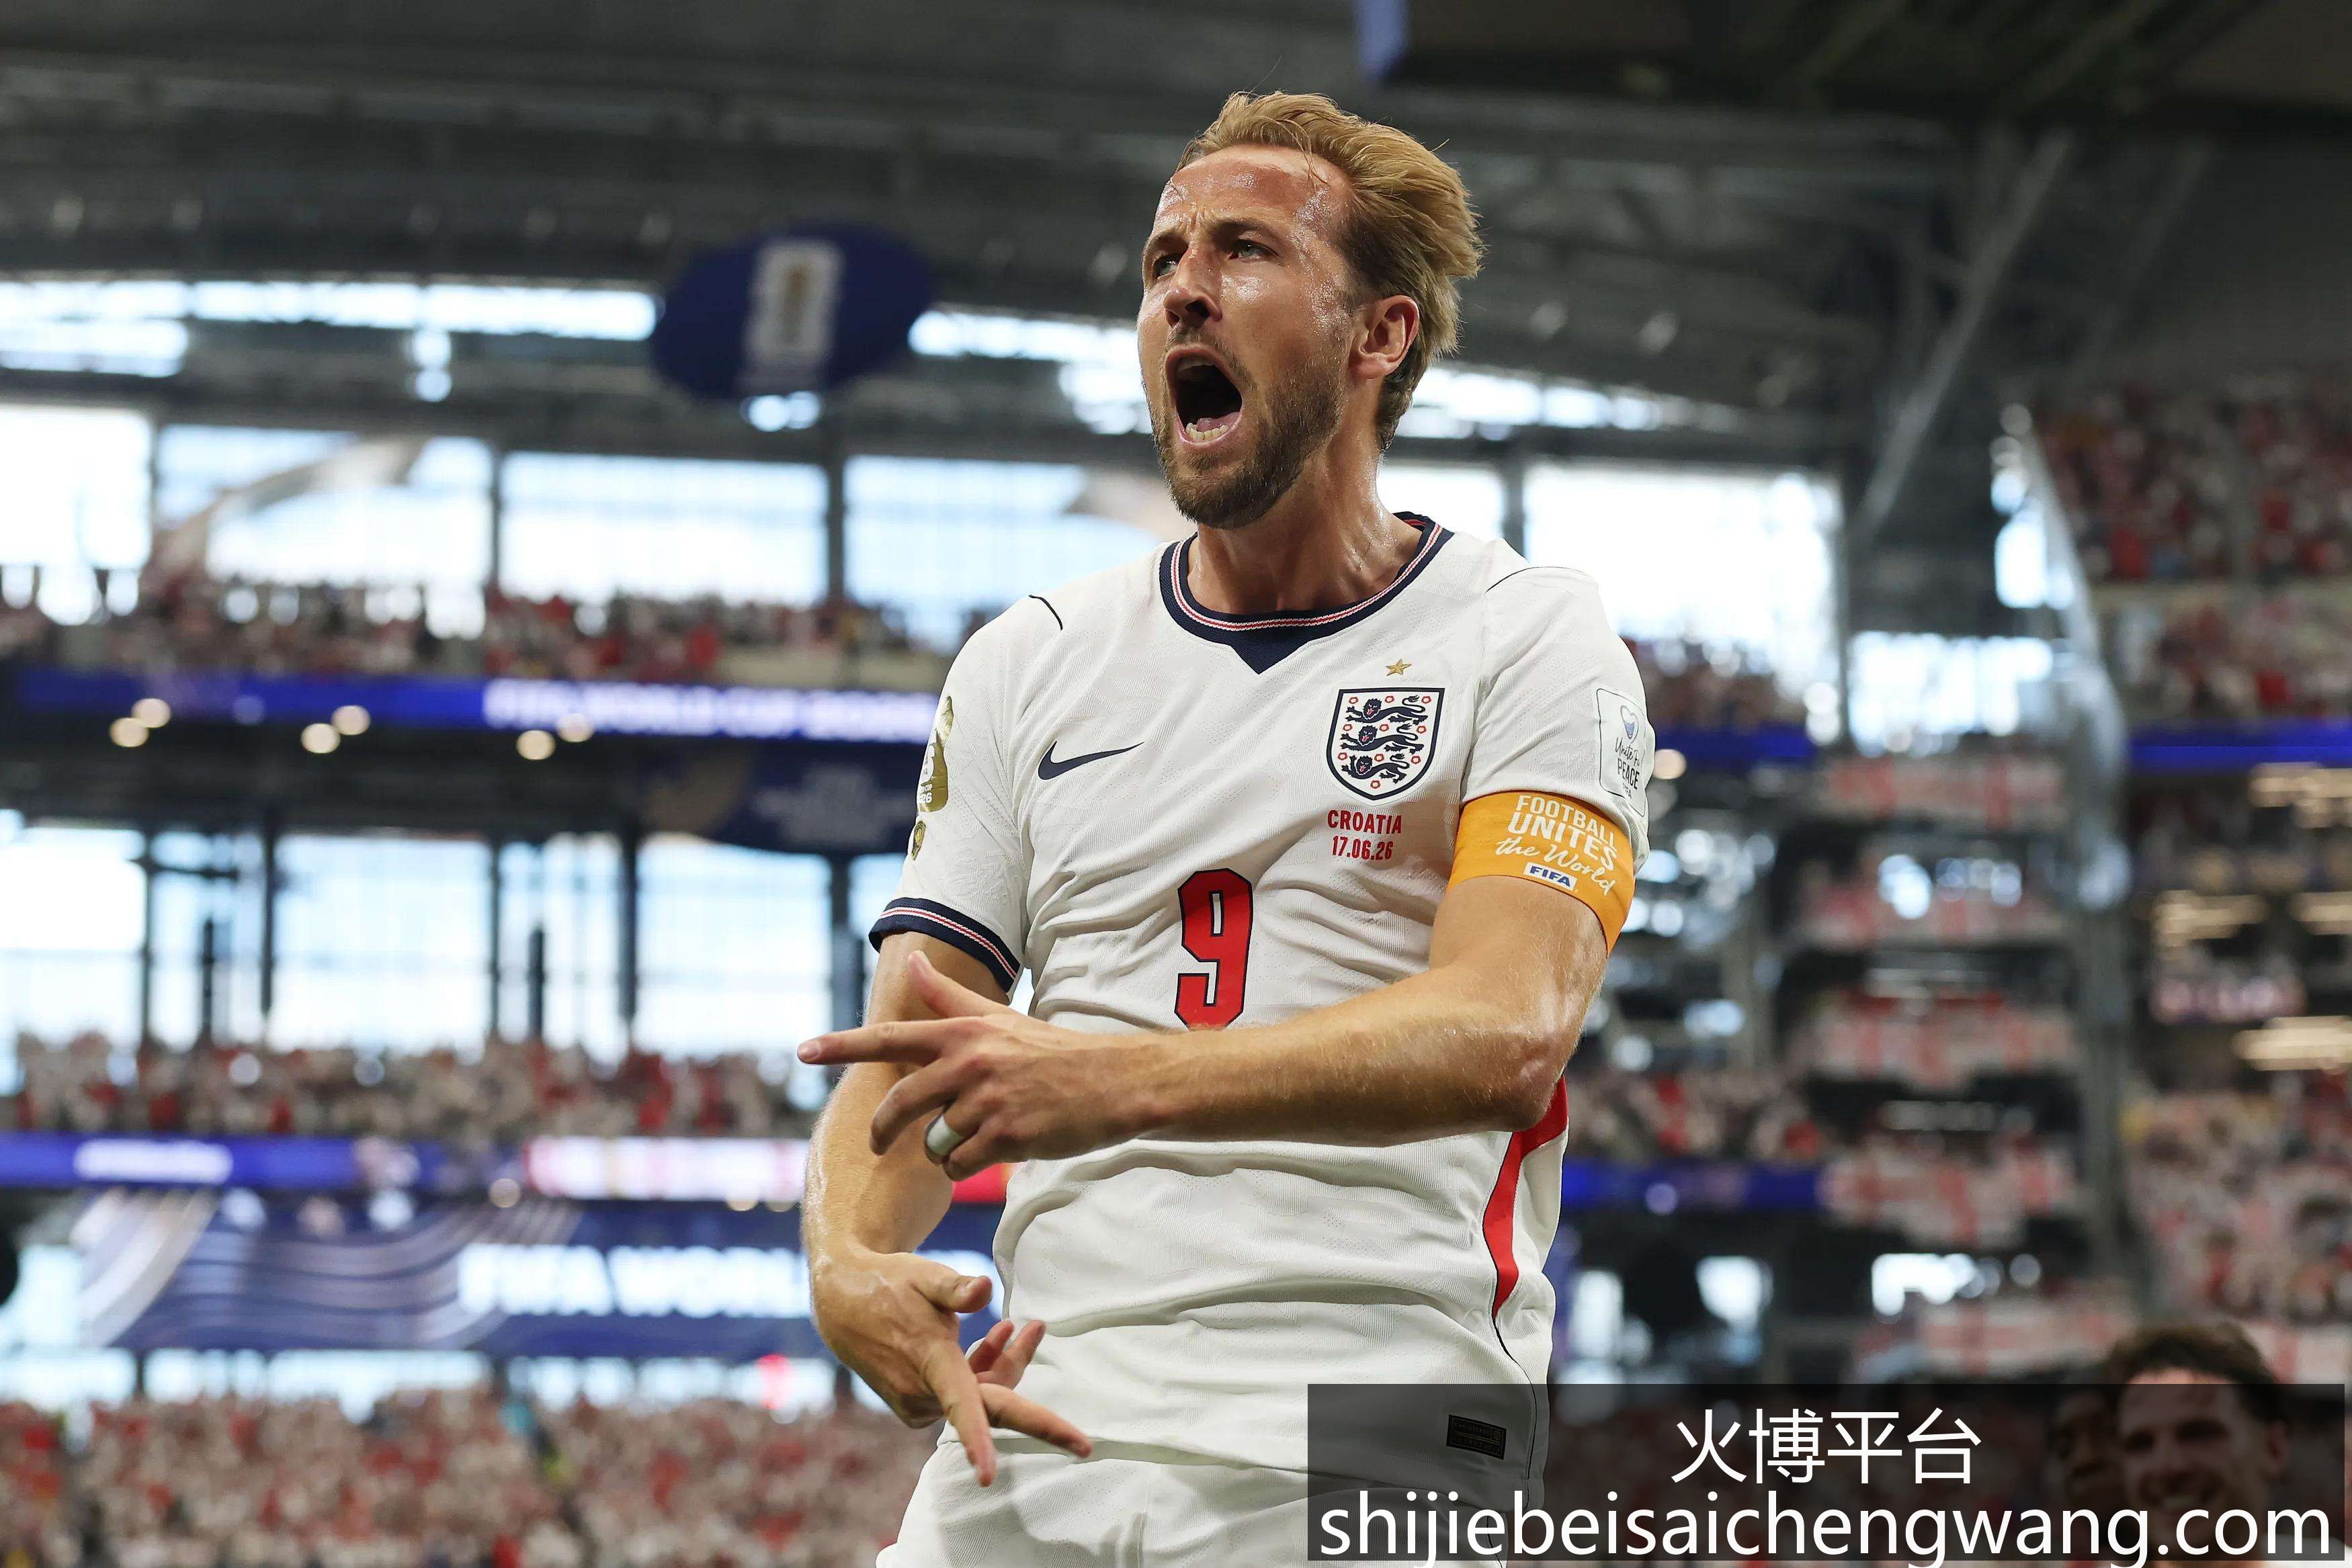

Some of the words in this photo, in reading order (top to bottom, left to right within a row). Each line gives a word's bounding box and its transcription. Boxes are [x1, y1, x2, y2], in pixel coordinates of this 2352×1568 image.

[1615, 736, 1634, 761] Unite
[1618, 757, 1640, 790] PEACE
[1327, 810, 1402, 834] CROATIA
[1507, 812, 1618, 871] UNITES
[1515, 795, 1618, 853] FOOTBALL
[1333, 835, 1394, 861] 17.06.26
[1495, 836, 1540, 857] the
[1543, 844, 1616, 896] World
[1529, 865, 1571, 887] FIFA
[1174, 867, 1253, 1032] 9
[606, 1244, 810, 1319] WORL
